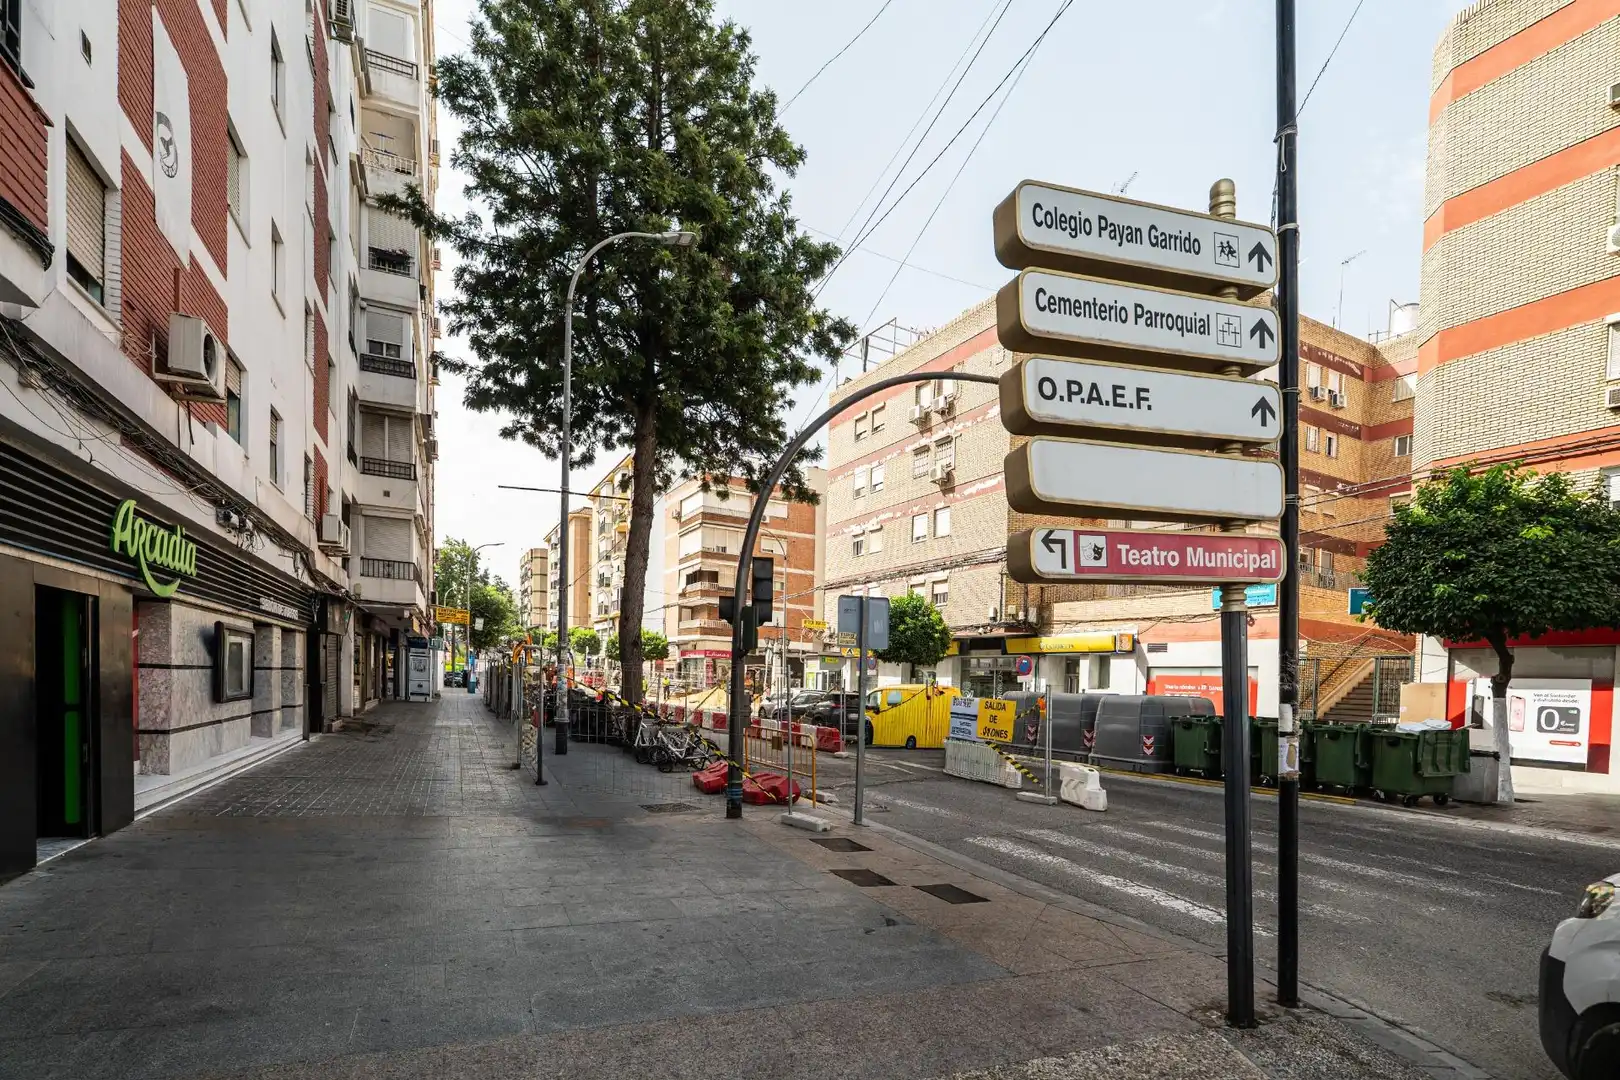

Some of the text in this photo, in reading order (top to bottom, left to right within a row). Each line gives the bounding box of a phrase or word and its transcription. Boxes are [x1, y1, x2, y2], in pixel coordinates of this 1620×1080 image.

[1032, 202, 1201, 256] Colegio Payan Garrido
[1035, 287, 1211, 337] Cementerio Parroquial
[1037, 376, 1153, 411] O.P.A.E.F.
[112, 499, 198, 597] Arcadia
[1117, 544, 1276, 572] Teatro Municipal
[985, 701, 1006, 711] SALIDA
[989, 714, 998, 724] DE
